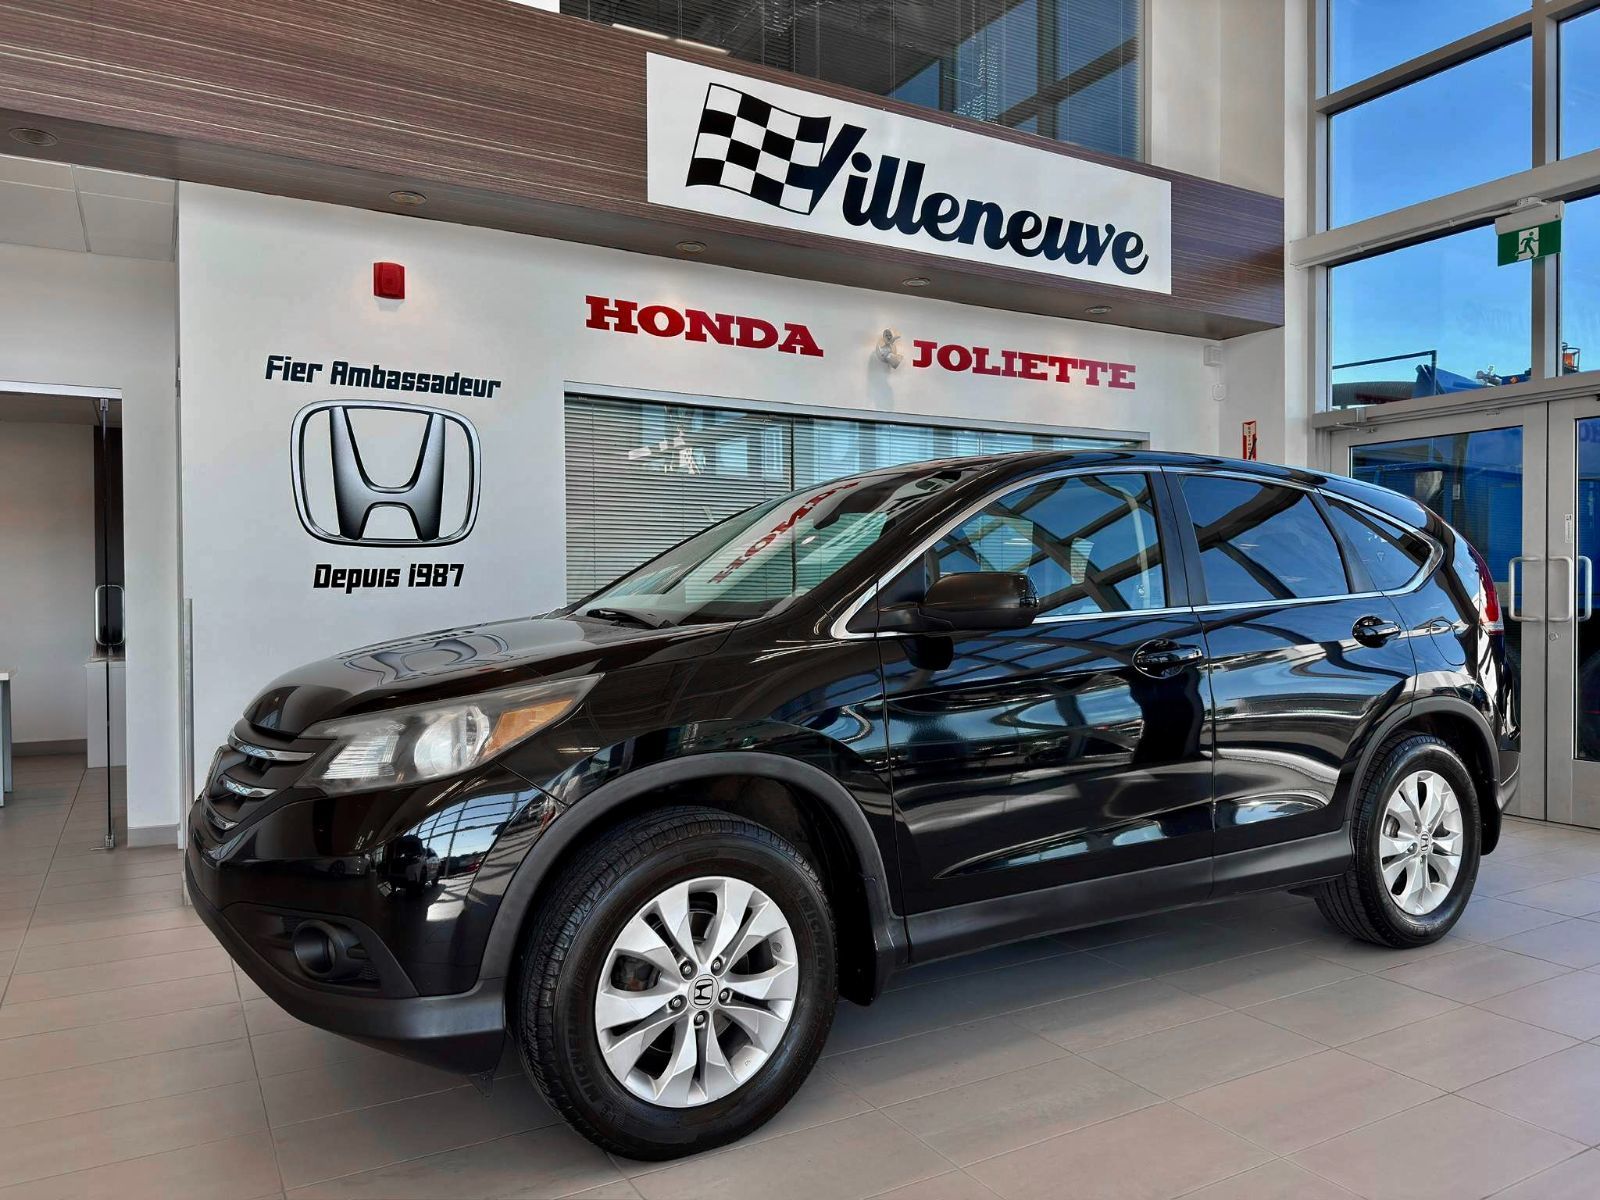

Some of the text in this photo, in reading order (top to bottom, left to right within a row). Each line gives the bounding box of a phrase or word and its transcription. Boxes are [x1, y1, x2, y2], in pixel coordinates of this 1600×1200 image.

[808, 123, 1150, 275] Villeneuve
[586, 295, 1136, 389] HONDA JOLIETTE
[265, 355, 502, 399] Fier Ambassadeur
[314, 563, 465, 594] Depuis 1987
